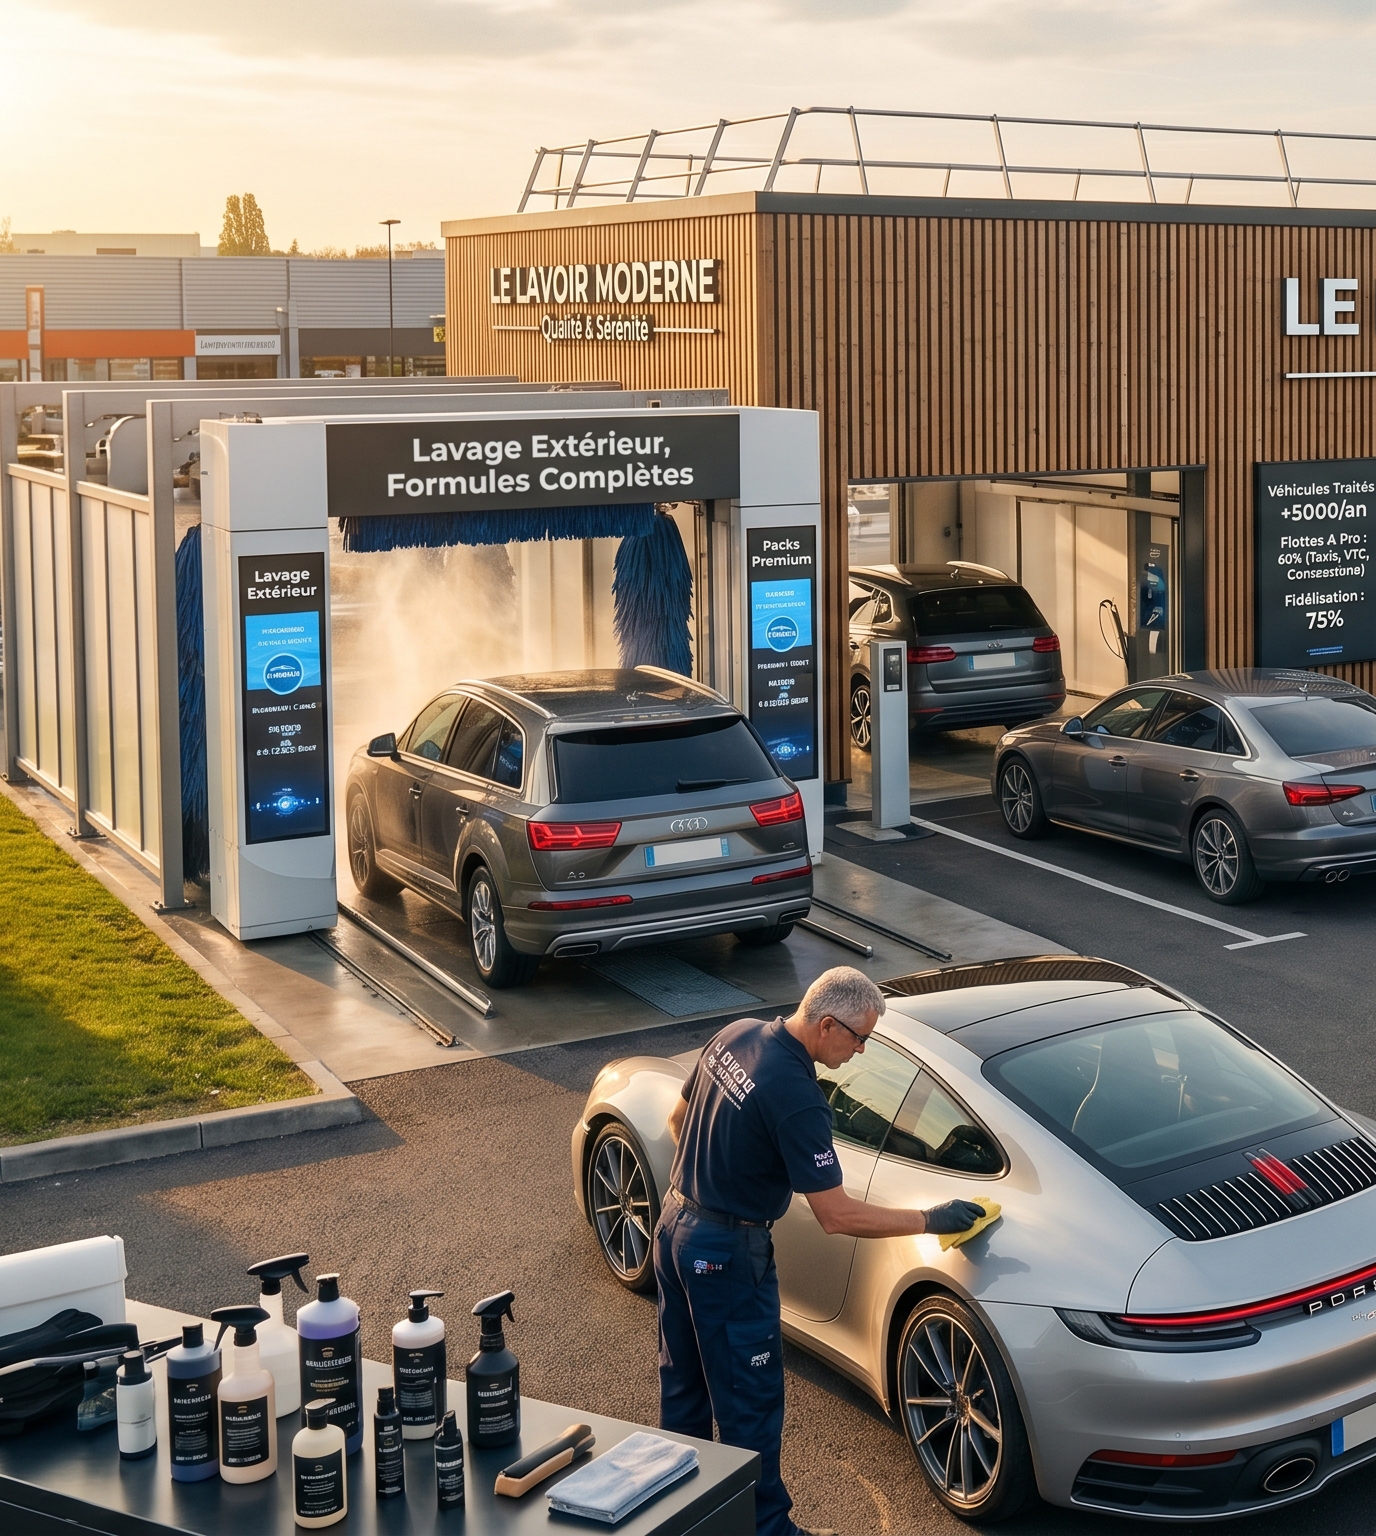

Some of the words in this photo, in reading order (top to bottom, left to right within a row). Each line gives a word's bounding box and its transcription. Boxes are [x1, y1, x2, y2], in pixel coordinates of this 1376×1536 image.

[490, 267, 511, 304] LE
[516, 264, 589, 304] LAVOIR
[596, 259, 715, 304] MODERNE
[1284, 277, 1360, 336] LE
[585, 315, 594, 340] &
[596, 314, 649, 341] Sérénité
[413, 438, 522, 465] Lavage
[531, 430, 671, 459] Extérieur,
[387, 469, 531, 497] Formules
[539, 462, 695, 493] Complètes
[1267, 483, 1330, 497] Véhicules
[1332, 480, 1375, 495] Traités
[1281, 499, 1367, 522] +5000/an
[763, 539, 800, 551] Packs
[1280, 535, 1324, 549] Flottes
[1326, 534, 1337, 546] A
[1340, 533, 1361, 545] Pro
[752, 554, 812, 567] Premium
[1277, 553, 1303, 565] 60%
[1305, 550, 1342, 566] (Taxis,
[1343, 548, 1370, 562] VTC,
[254, 570, 310, 584] Lavage
[247, 585, 317, 599] Extérieur
[1285, 590, 1358, 607] Fidélisation
[1305, 609, 1344, 630] 75%
